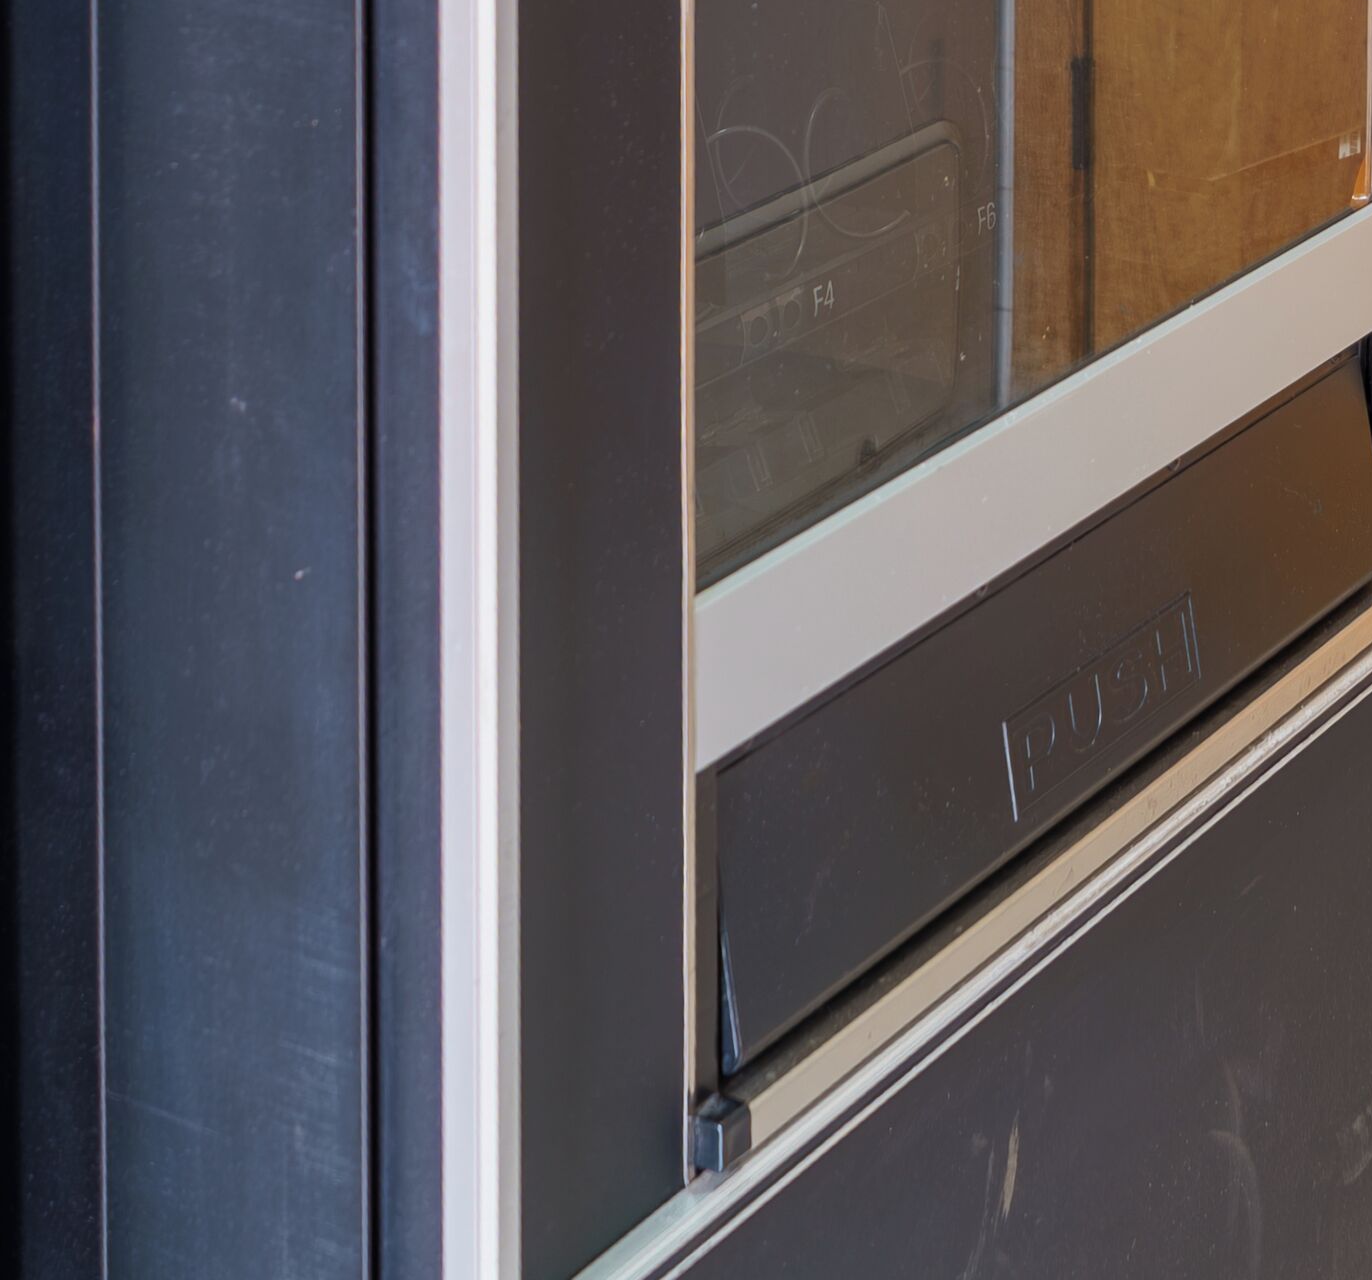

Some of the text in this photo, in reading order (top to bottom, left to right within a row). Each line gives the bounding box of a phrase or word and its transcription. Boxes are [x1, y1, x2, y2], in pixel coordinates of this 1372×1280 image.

[977, 202, 996, 236] F6
[813, 279, 835, 318] F4
[1017, 610, 1193, 792] PUSH
